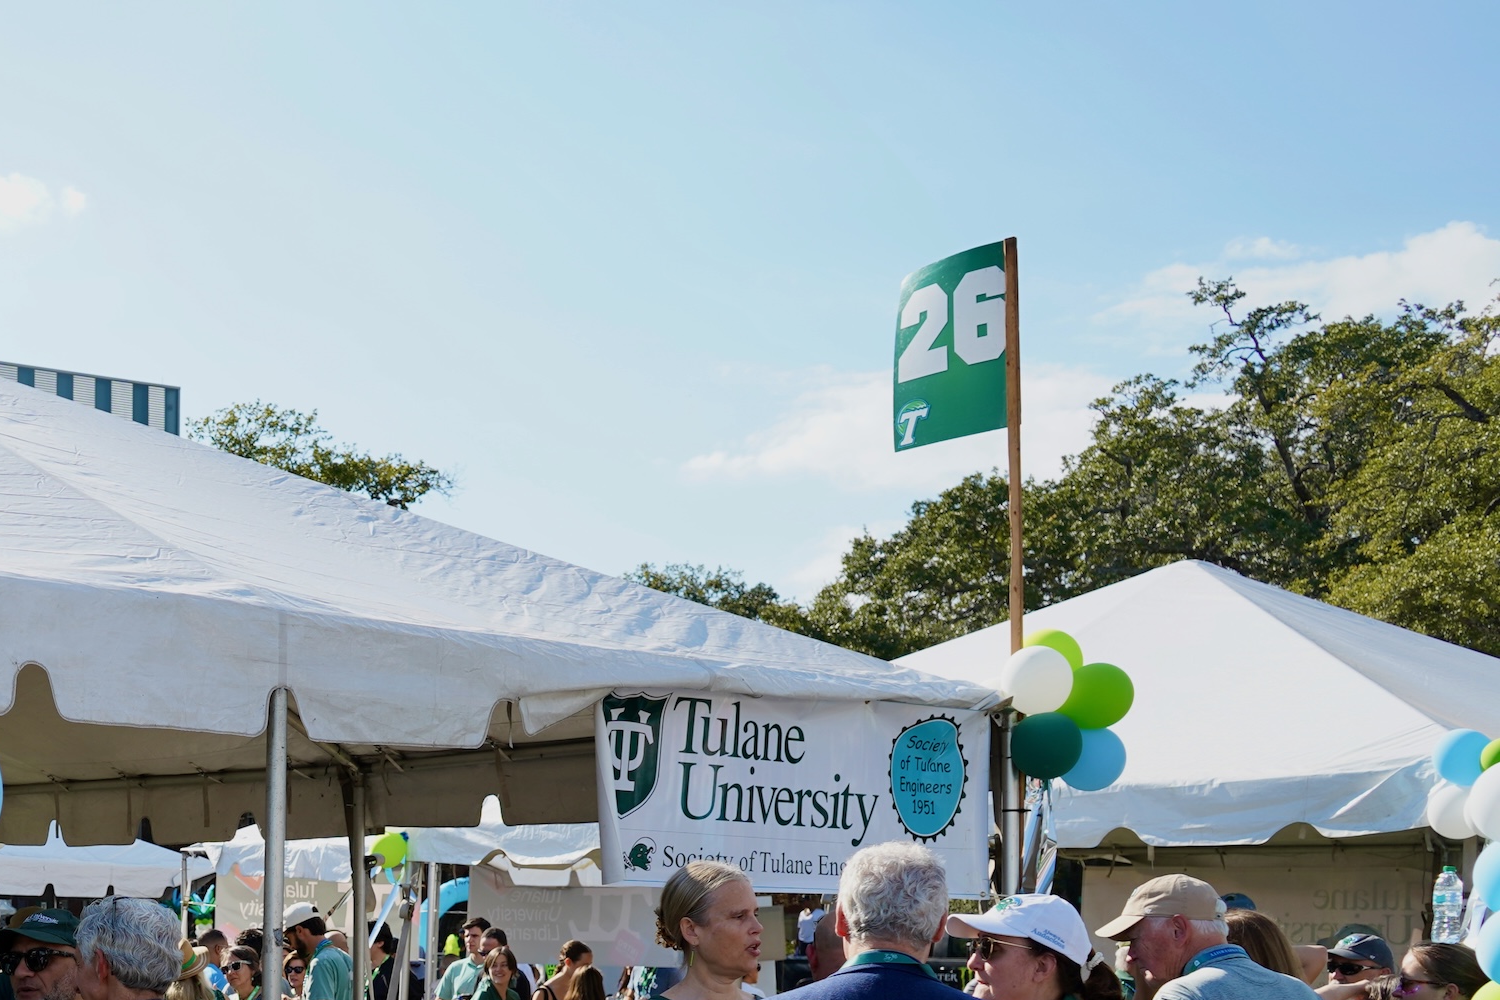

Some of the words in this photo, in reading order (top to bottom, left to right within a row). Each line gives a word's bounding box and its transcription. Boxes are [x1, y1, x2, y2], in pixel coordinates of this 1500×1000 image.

[898, 265, 1007, 384] 26
[673, 696, 806, 764] Tulane
[906, 735, 950, 756] Society
[900, 755, 911, 772] of
[915, 756, 952, 773] Tulane
[900, 776, 952, 797] Engineers
[678, 761, 880, 847] University
[912, 799, 935, 815] 1951
[739, 850, 758, 872] of
[760, 851, 813, 875] Tulane
